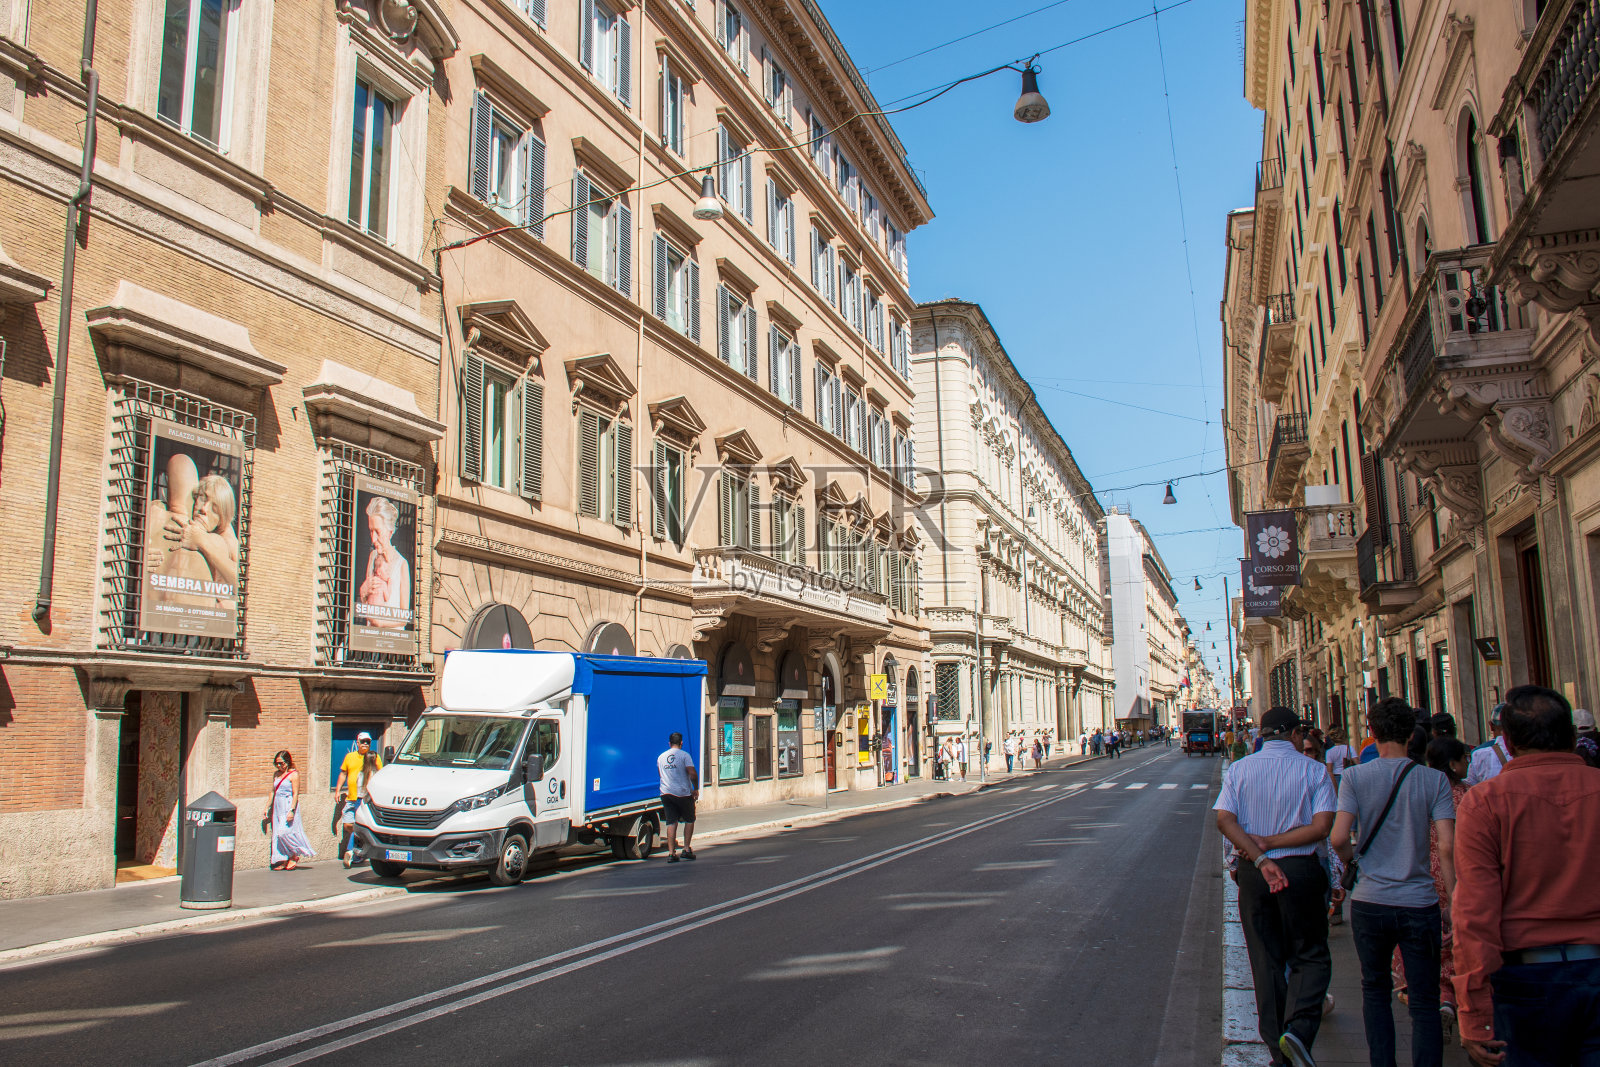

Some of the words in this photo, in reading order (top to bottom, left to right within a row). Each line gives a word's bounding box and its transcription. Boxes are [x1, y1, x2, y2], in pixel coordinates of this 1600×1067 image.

[168, 428, 194, 440] PALAZZO
[197, 436, 231, 450] BONAPARTE
[1254, 565, 1284, 574] CORSO
[150, 574, 202, 592] SEMBRA
[204, 581, 234, 595] VIVO!
[356, 603, 391, 616] SEMBRA
[392, 608, 413, 620] VIVO!
[392, 796, 428, 806] IVECO
